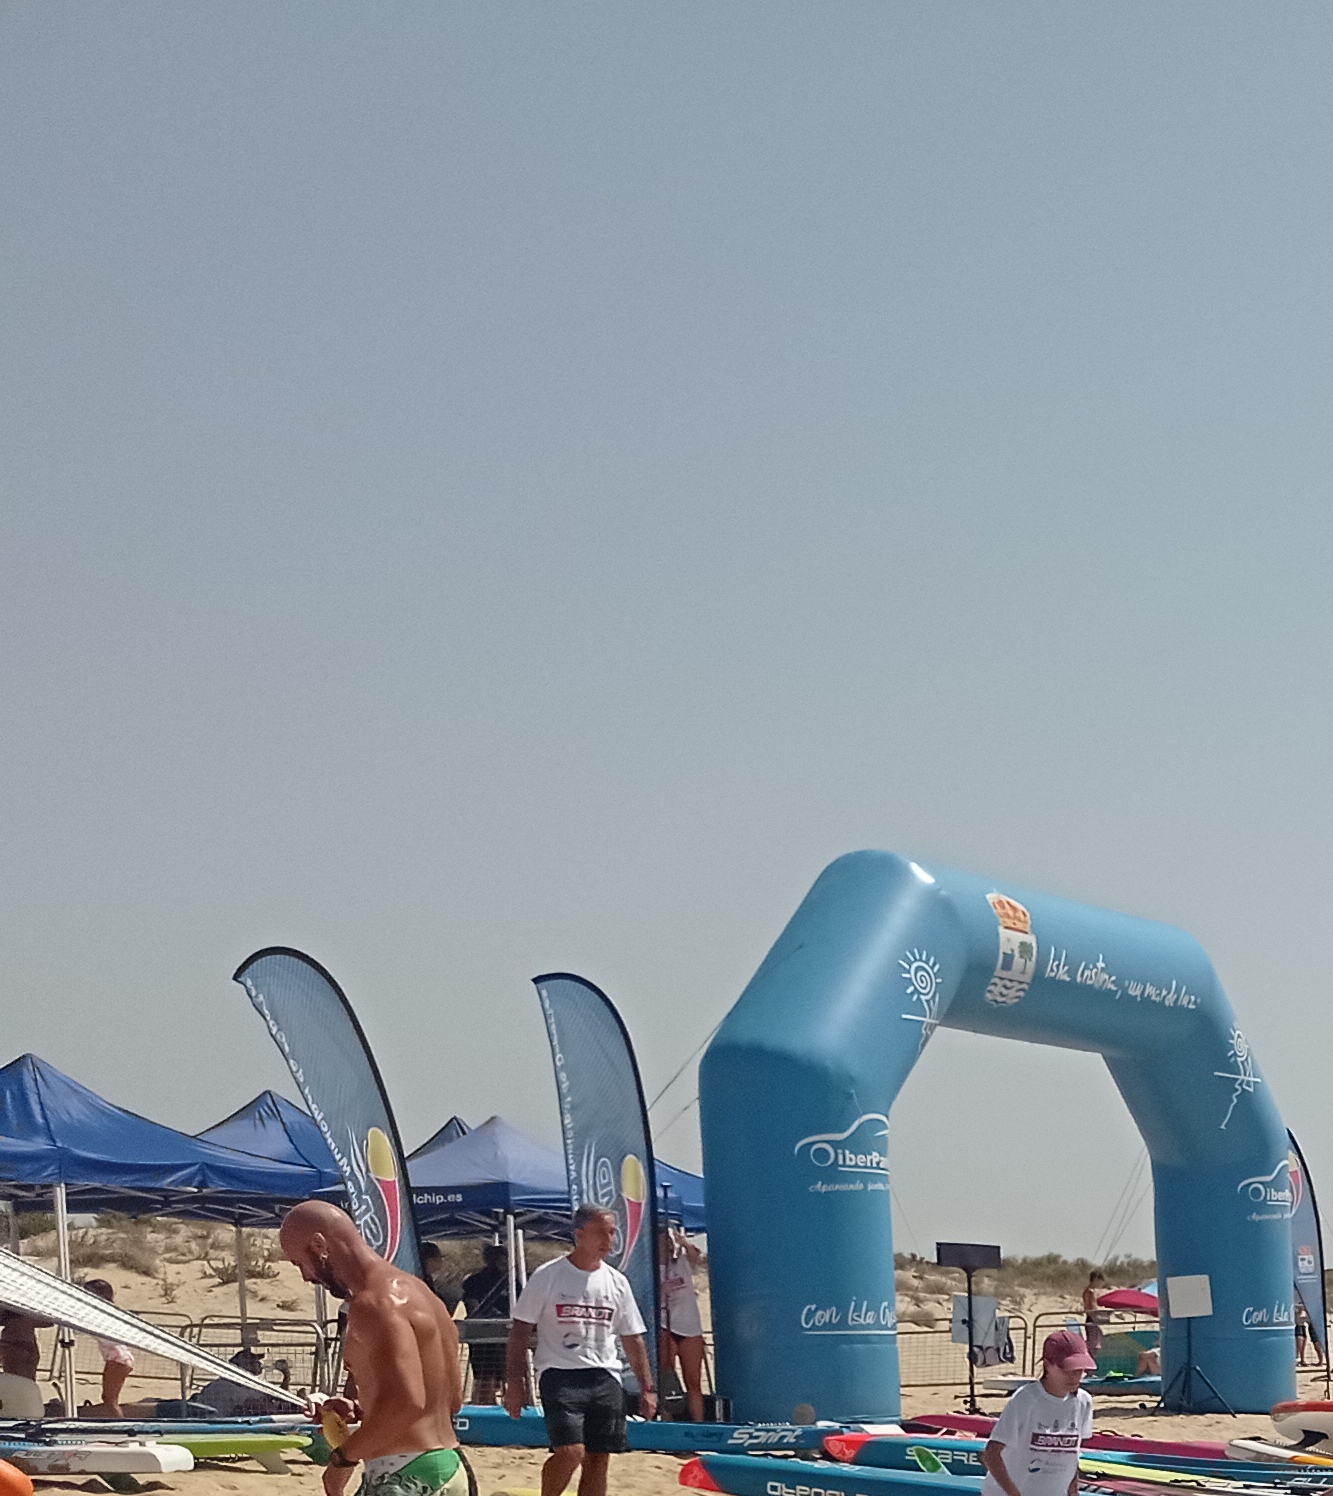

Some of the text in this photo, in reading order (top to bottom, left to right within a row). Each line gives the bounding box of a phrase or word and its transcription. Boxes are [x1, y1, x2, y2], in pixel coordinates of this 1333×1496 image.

[561, 1305, 610, 1320] BRANDT
[801, 1303, 842, 1329] Con
[1242, 1306, 1270, 1326] Con
[727, 1427, 804, 1447] Sprint
[1038, 1435, 1076, 1447] BRANDT
